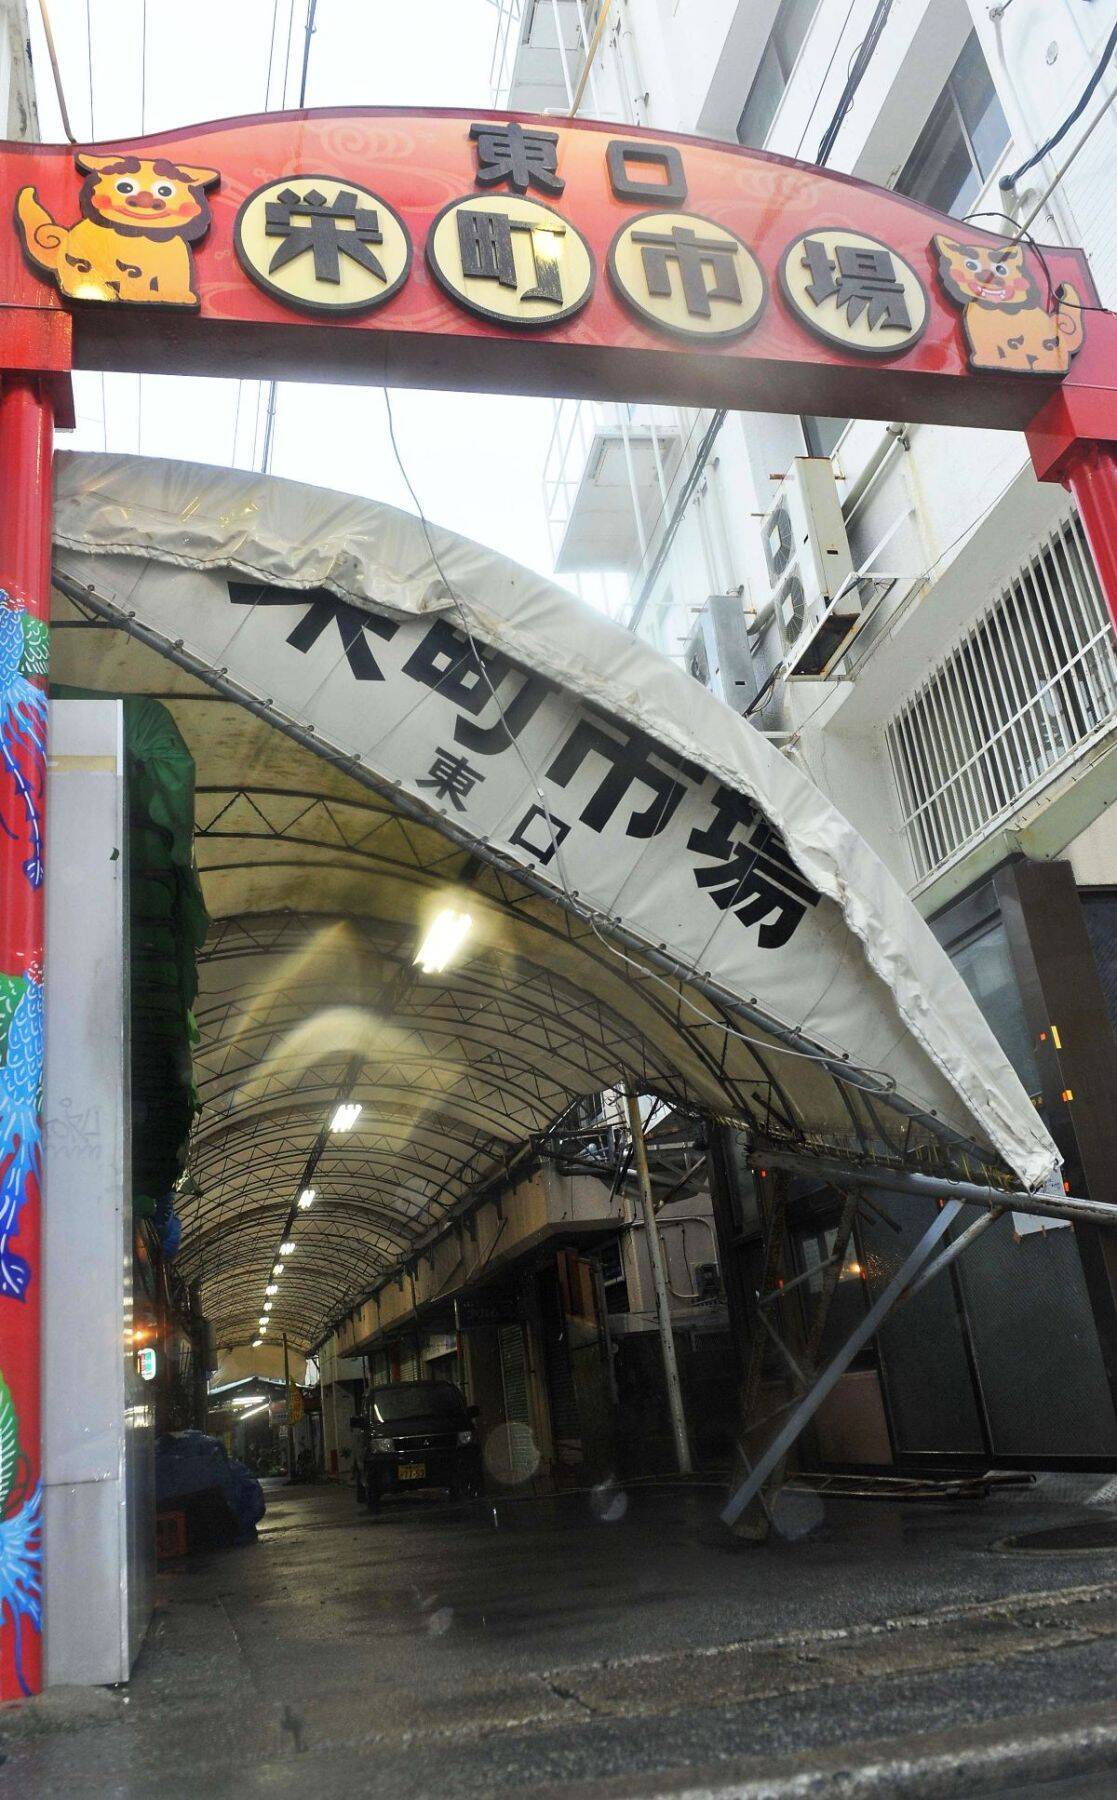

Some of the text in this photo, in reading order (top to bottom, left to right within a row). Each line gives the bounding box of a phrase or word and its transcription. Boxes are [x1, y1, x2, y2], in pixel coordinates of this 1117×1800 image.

[469, 122, 689, 204] 東口
[264, 187, 912, 334] 栄町市場
[415, 746, 572, 865] 東口
